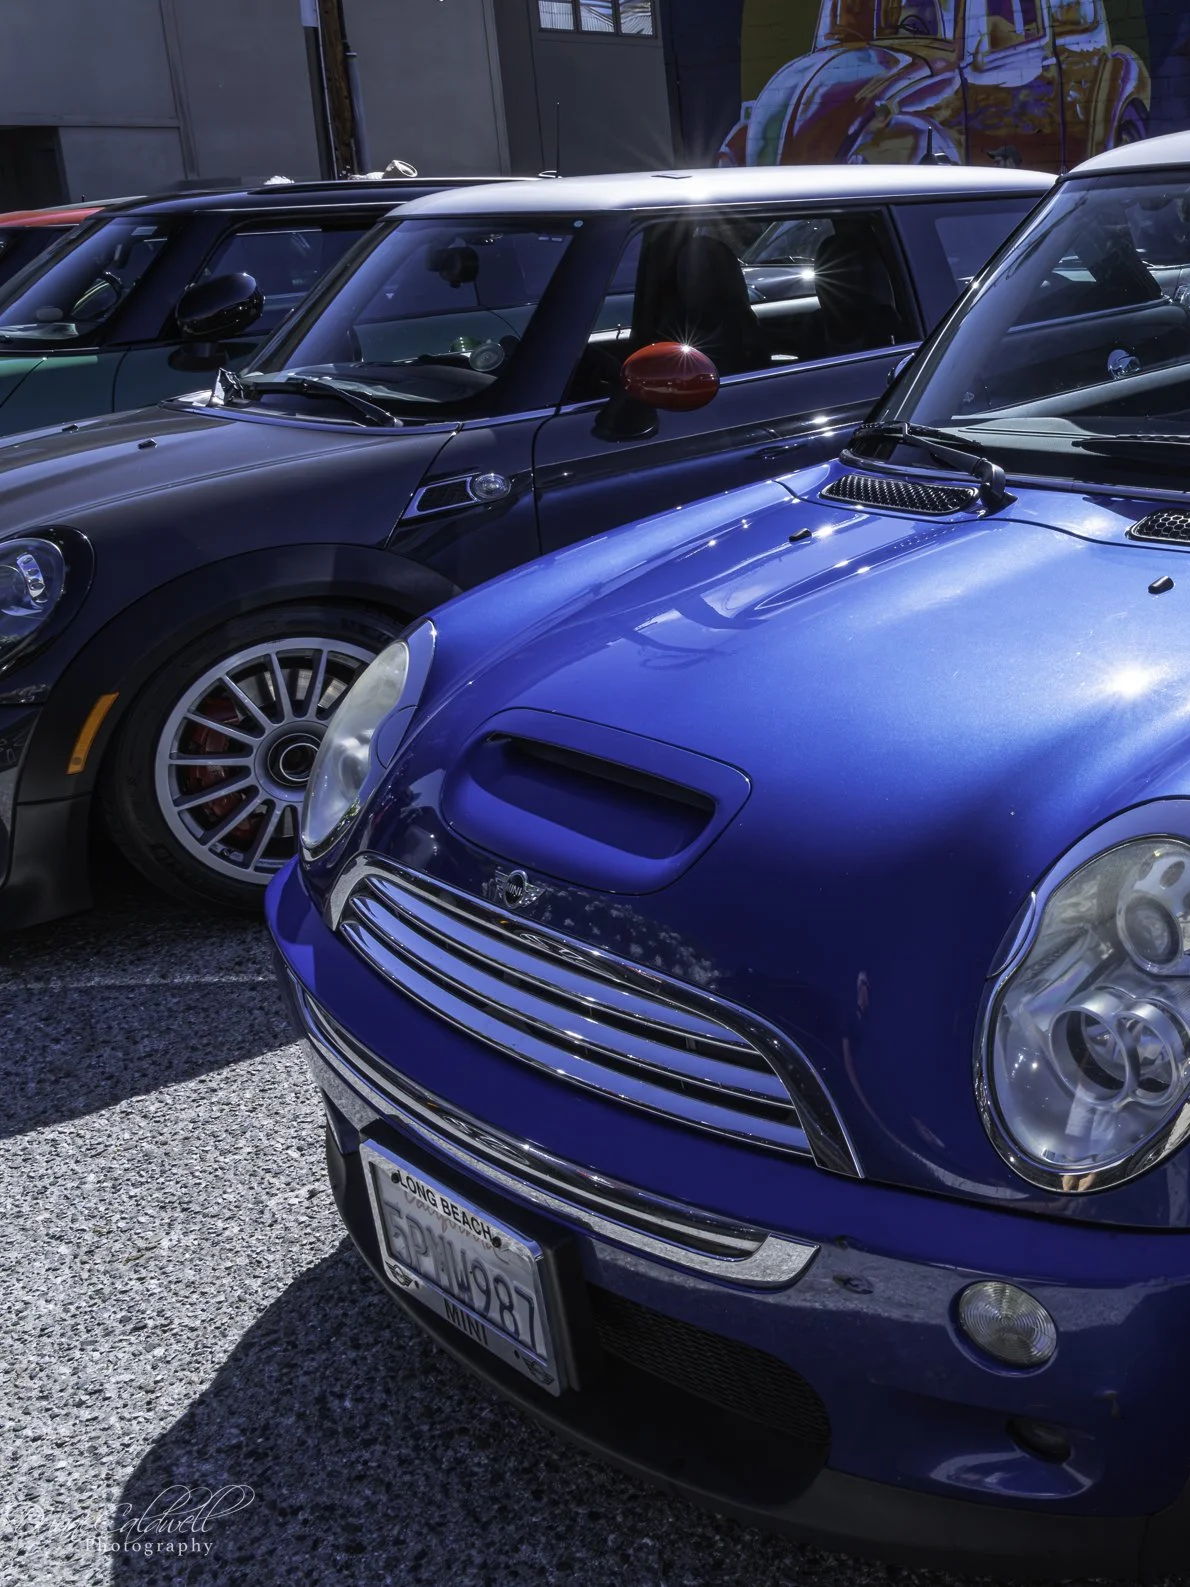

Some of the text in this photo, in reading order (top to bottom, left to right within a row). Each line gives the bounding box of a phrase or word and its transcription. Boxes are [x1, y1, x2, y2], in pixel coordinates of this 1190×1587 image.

[399, 1174, 492, 1240] LONG BEACH
[444, 1301, 488, 1346] MINI
